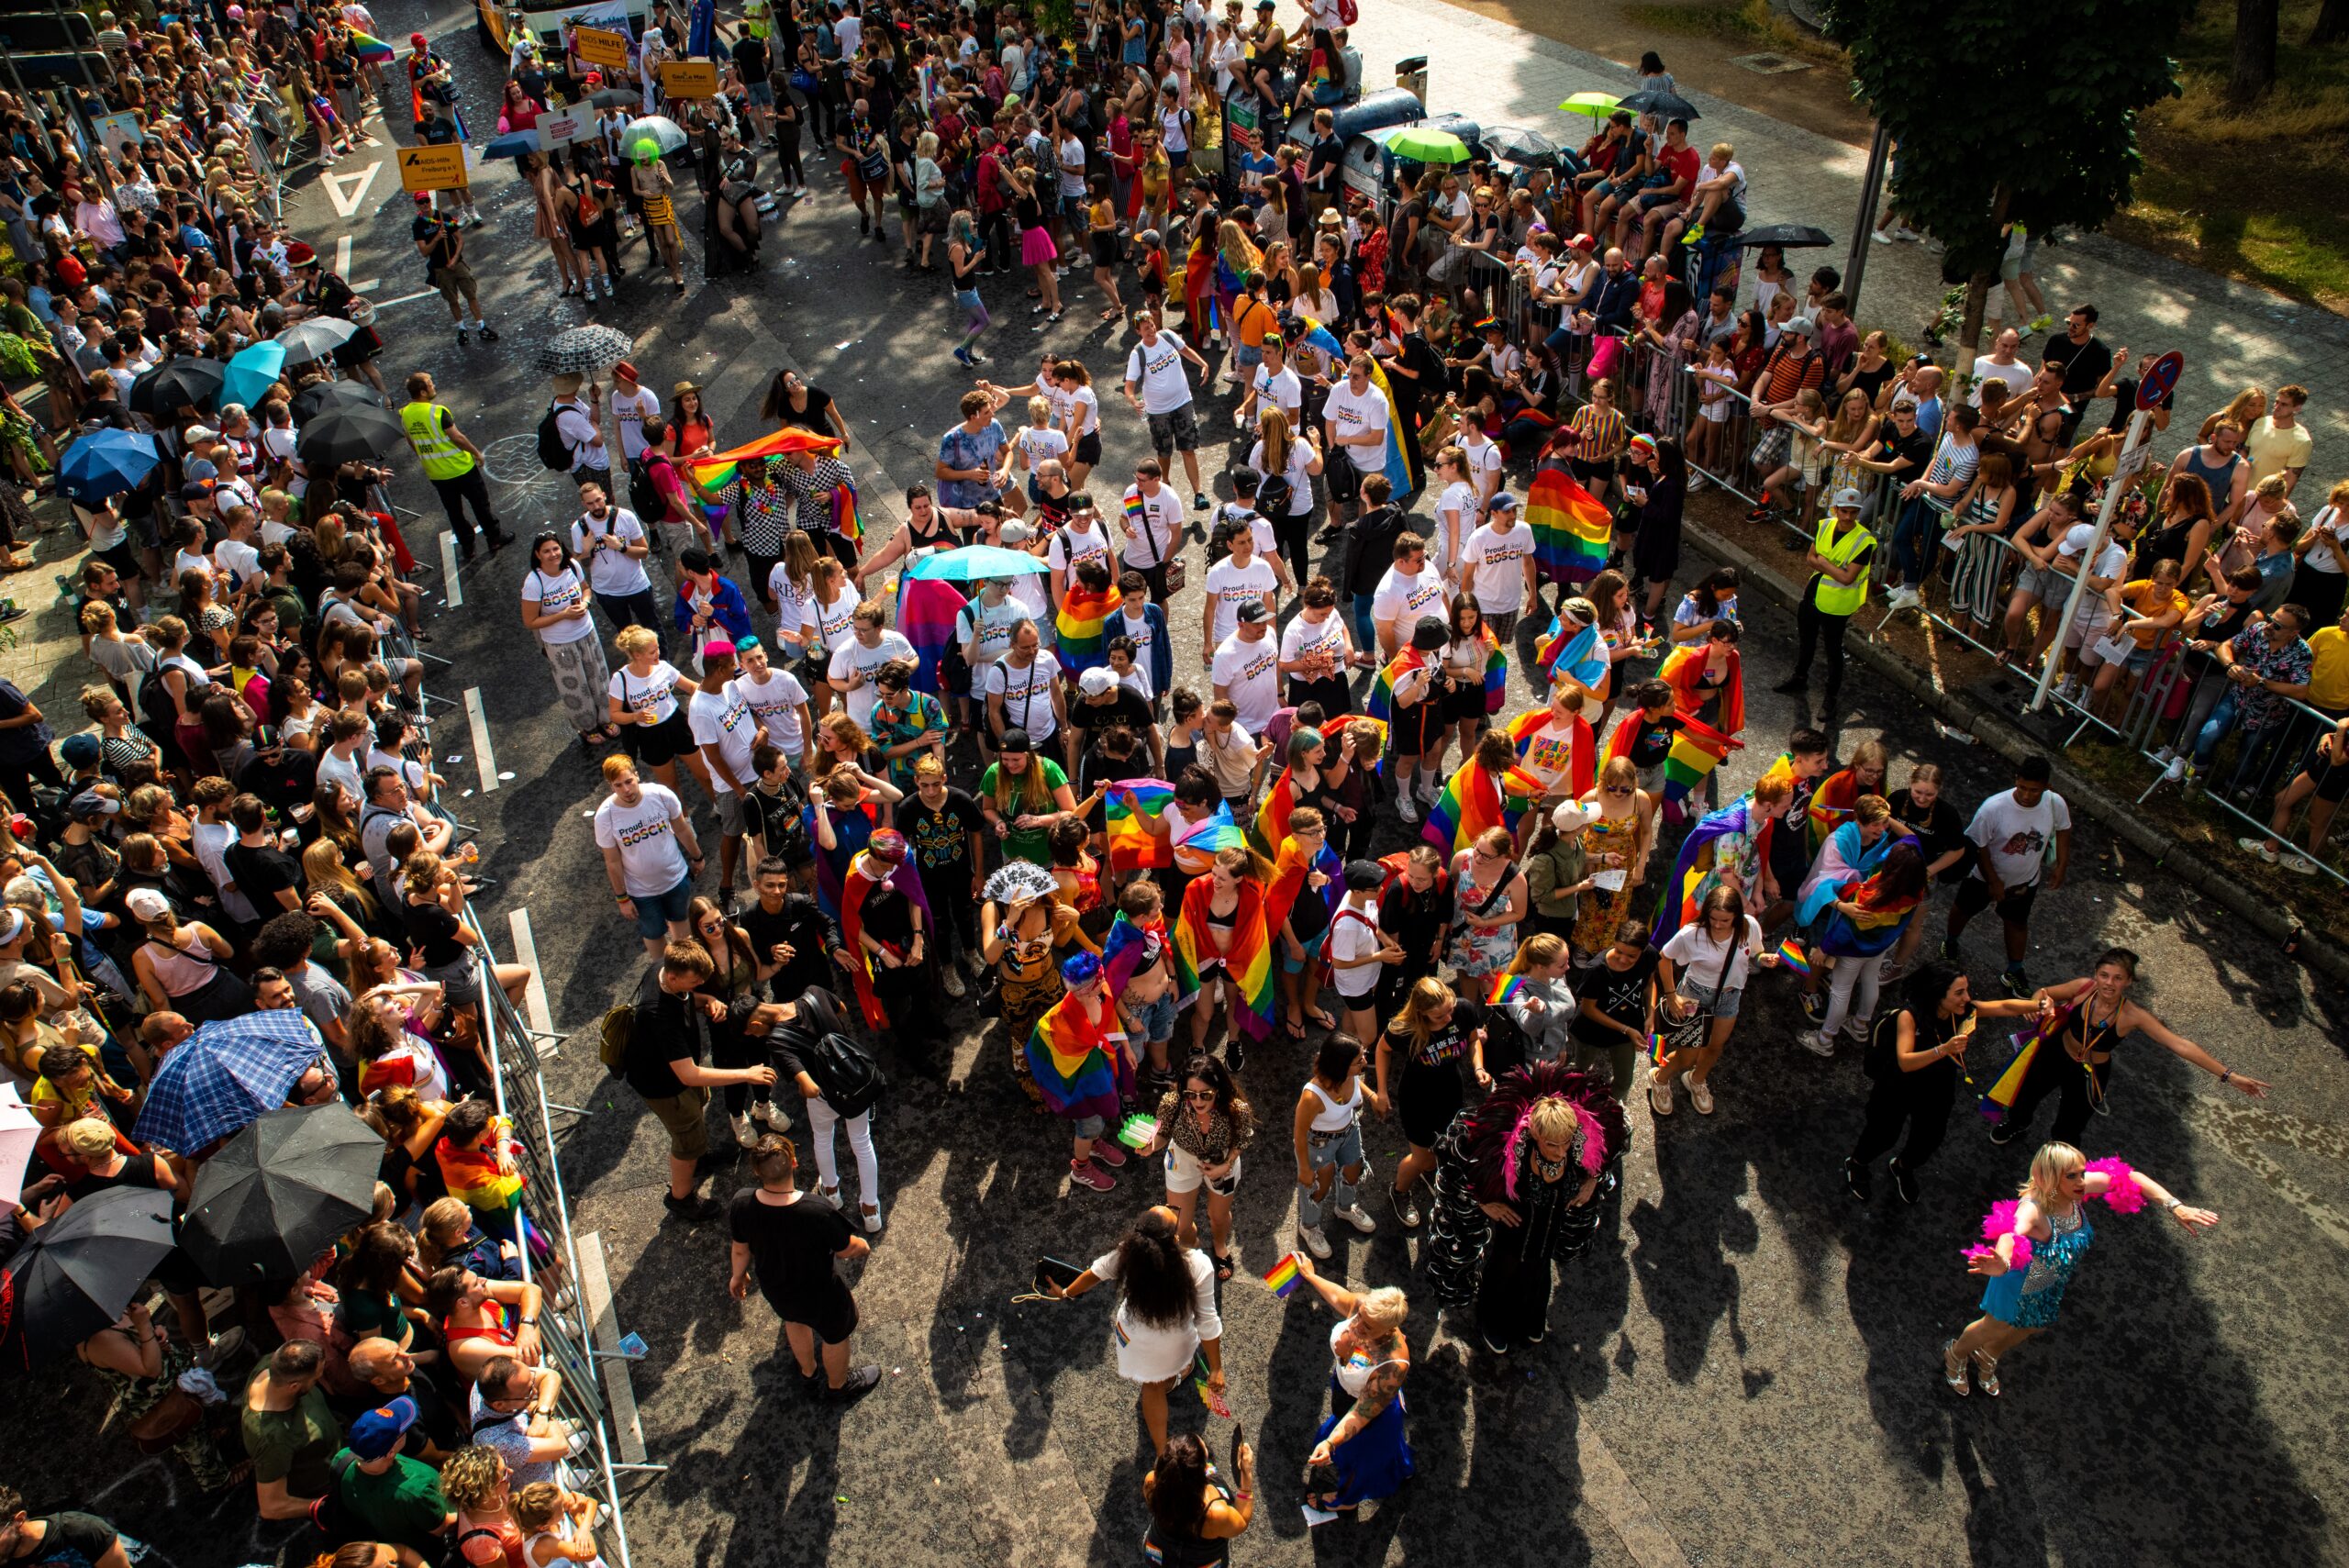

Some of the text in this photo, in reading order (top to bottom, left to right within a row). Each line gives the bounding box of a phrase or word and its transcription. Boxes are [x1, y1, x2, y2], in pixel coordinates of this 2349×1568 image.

[582, 35, 596, 44] AIDS
[598, 38, 621, 49] HILFE
[419, 157, 451, 165] AIDS-Hilfe
[1149, 351, 1179, 374] BOSCH
[1258, 388, 1278, 404] OSCH
[1486, 550, 1523, 565] BOSCH
[1223, 590, 1262, 602] BOSCH
[824, 616, 852, 636] BOSC
[757, 704, 790, 718] OSCH
[622, 820, 667, 846] BOSCH
[1669, 1024, 1695, 1045] adidas
[1420, 1039, 1468, 1067] HUMAN
[1426, 1035, 1459, 1054] WE ARE ALL
